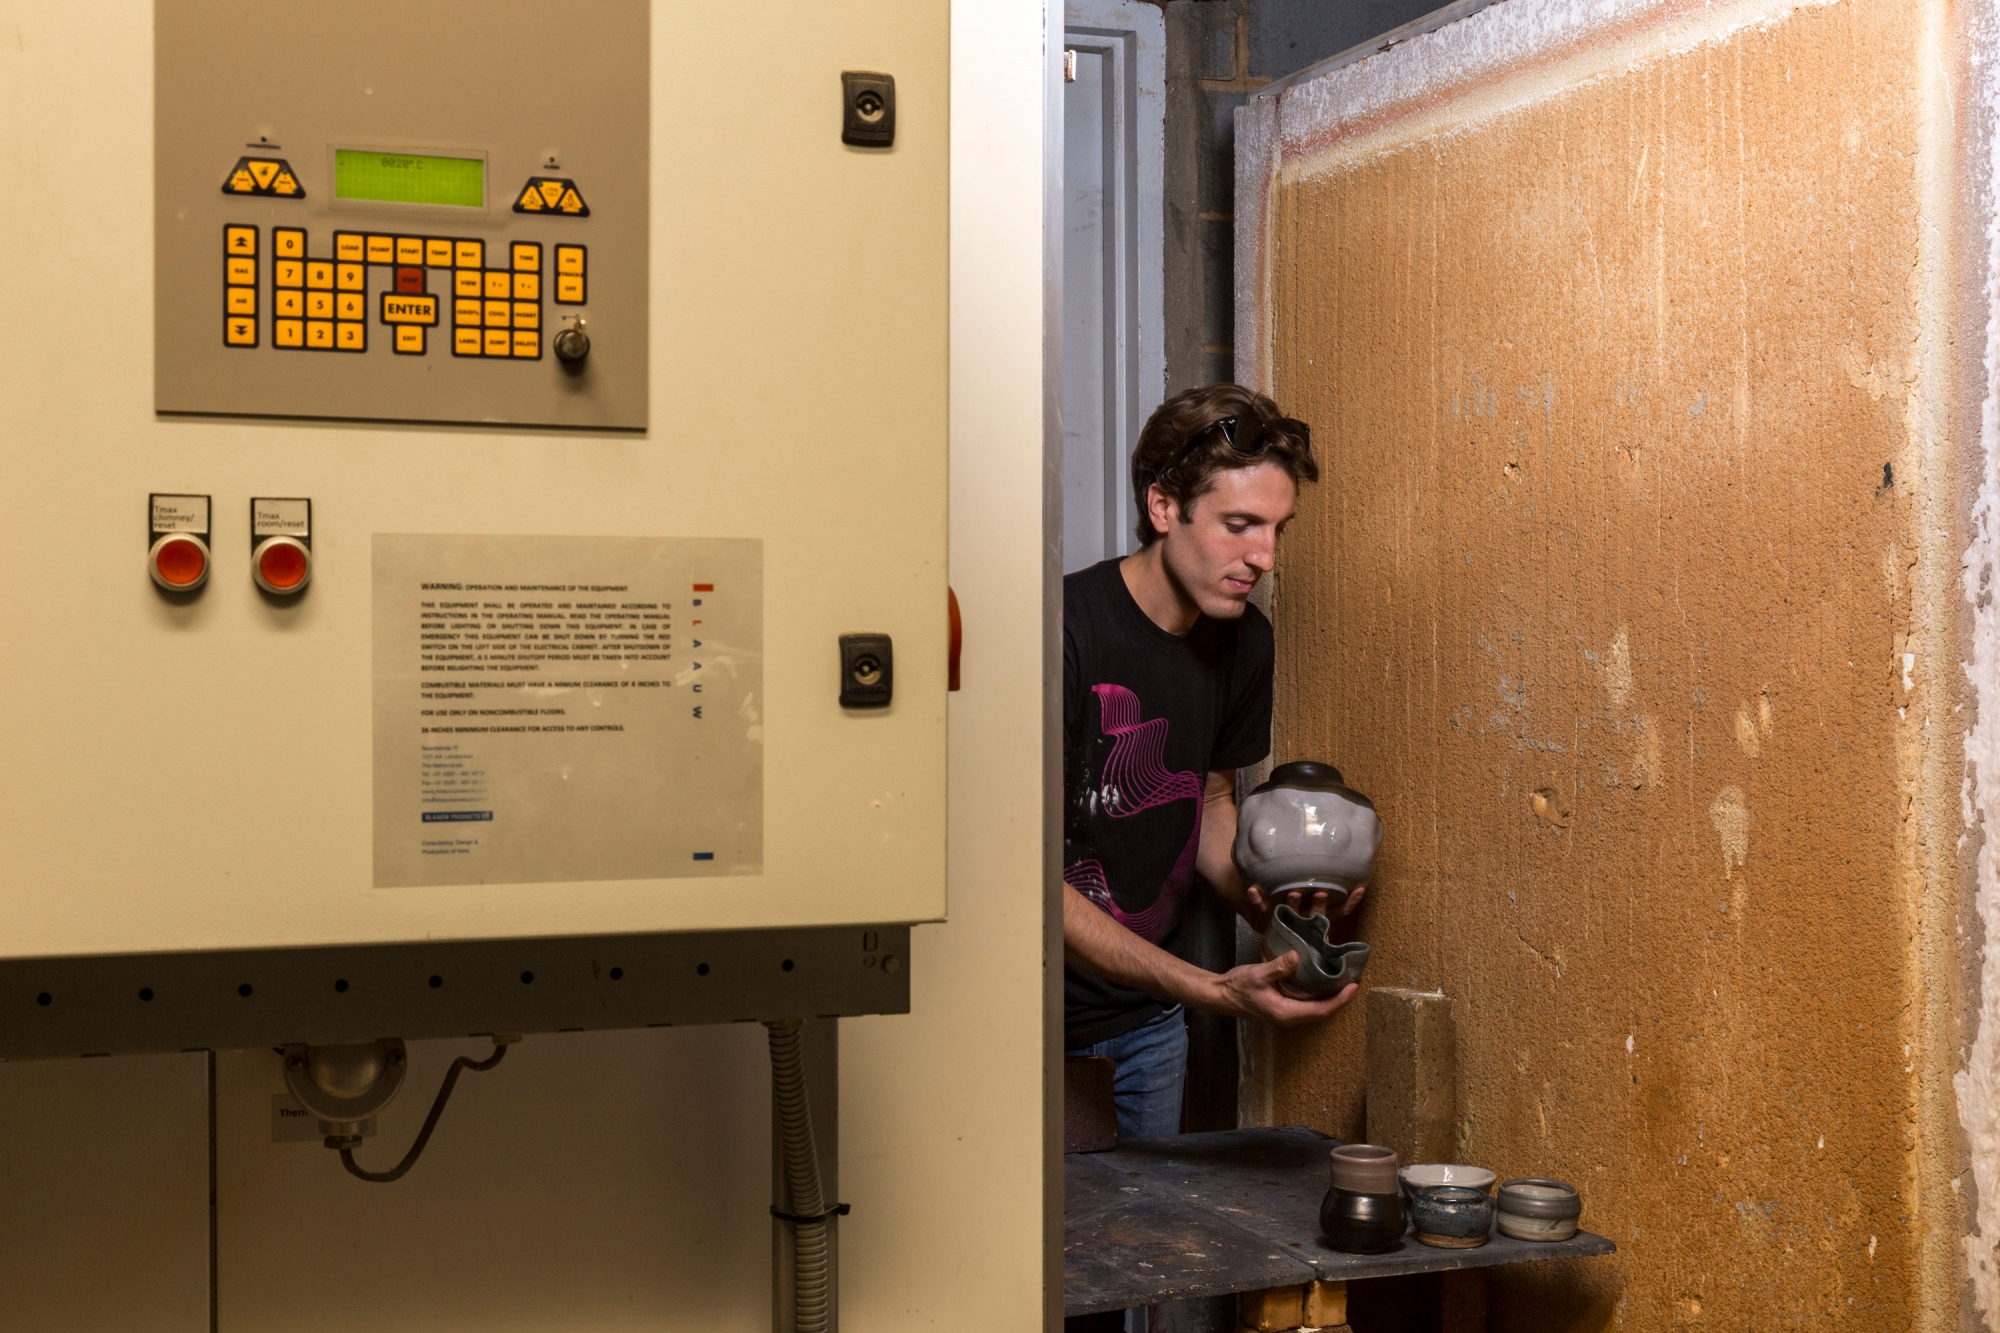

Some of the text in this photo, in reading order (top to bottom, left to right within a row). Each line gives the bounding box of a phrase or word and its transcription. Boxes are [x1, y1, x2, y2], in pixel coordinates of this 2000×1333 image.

[286, 239, 294, 249] 0
[286, 269, 293, 278] 7
[316, 270, 324, 280] 8
[346, 272, 354, 282] 9
[286, 299, 293, 308] 4
[317, 300, 324, 310] 5
[346, 302, 354, 311] 6
[388, 303, 431, 316] ENTER
[288, 328, 293, 338] 1
[317, 330, 324, 339] 2
[347, 331, 354, 341] 3
[154, 514, 194, 522] chimney/
[421, 582, 464, 591] WARNING:
[693, 599, 702, 719] BLAAUW
